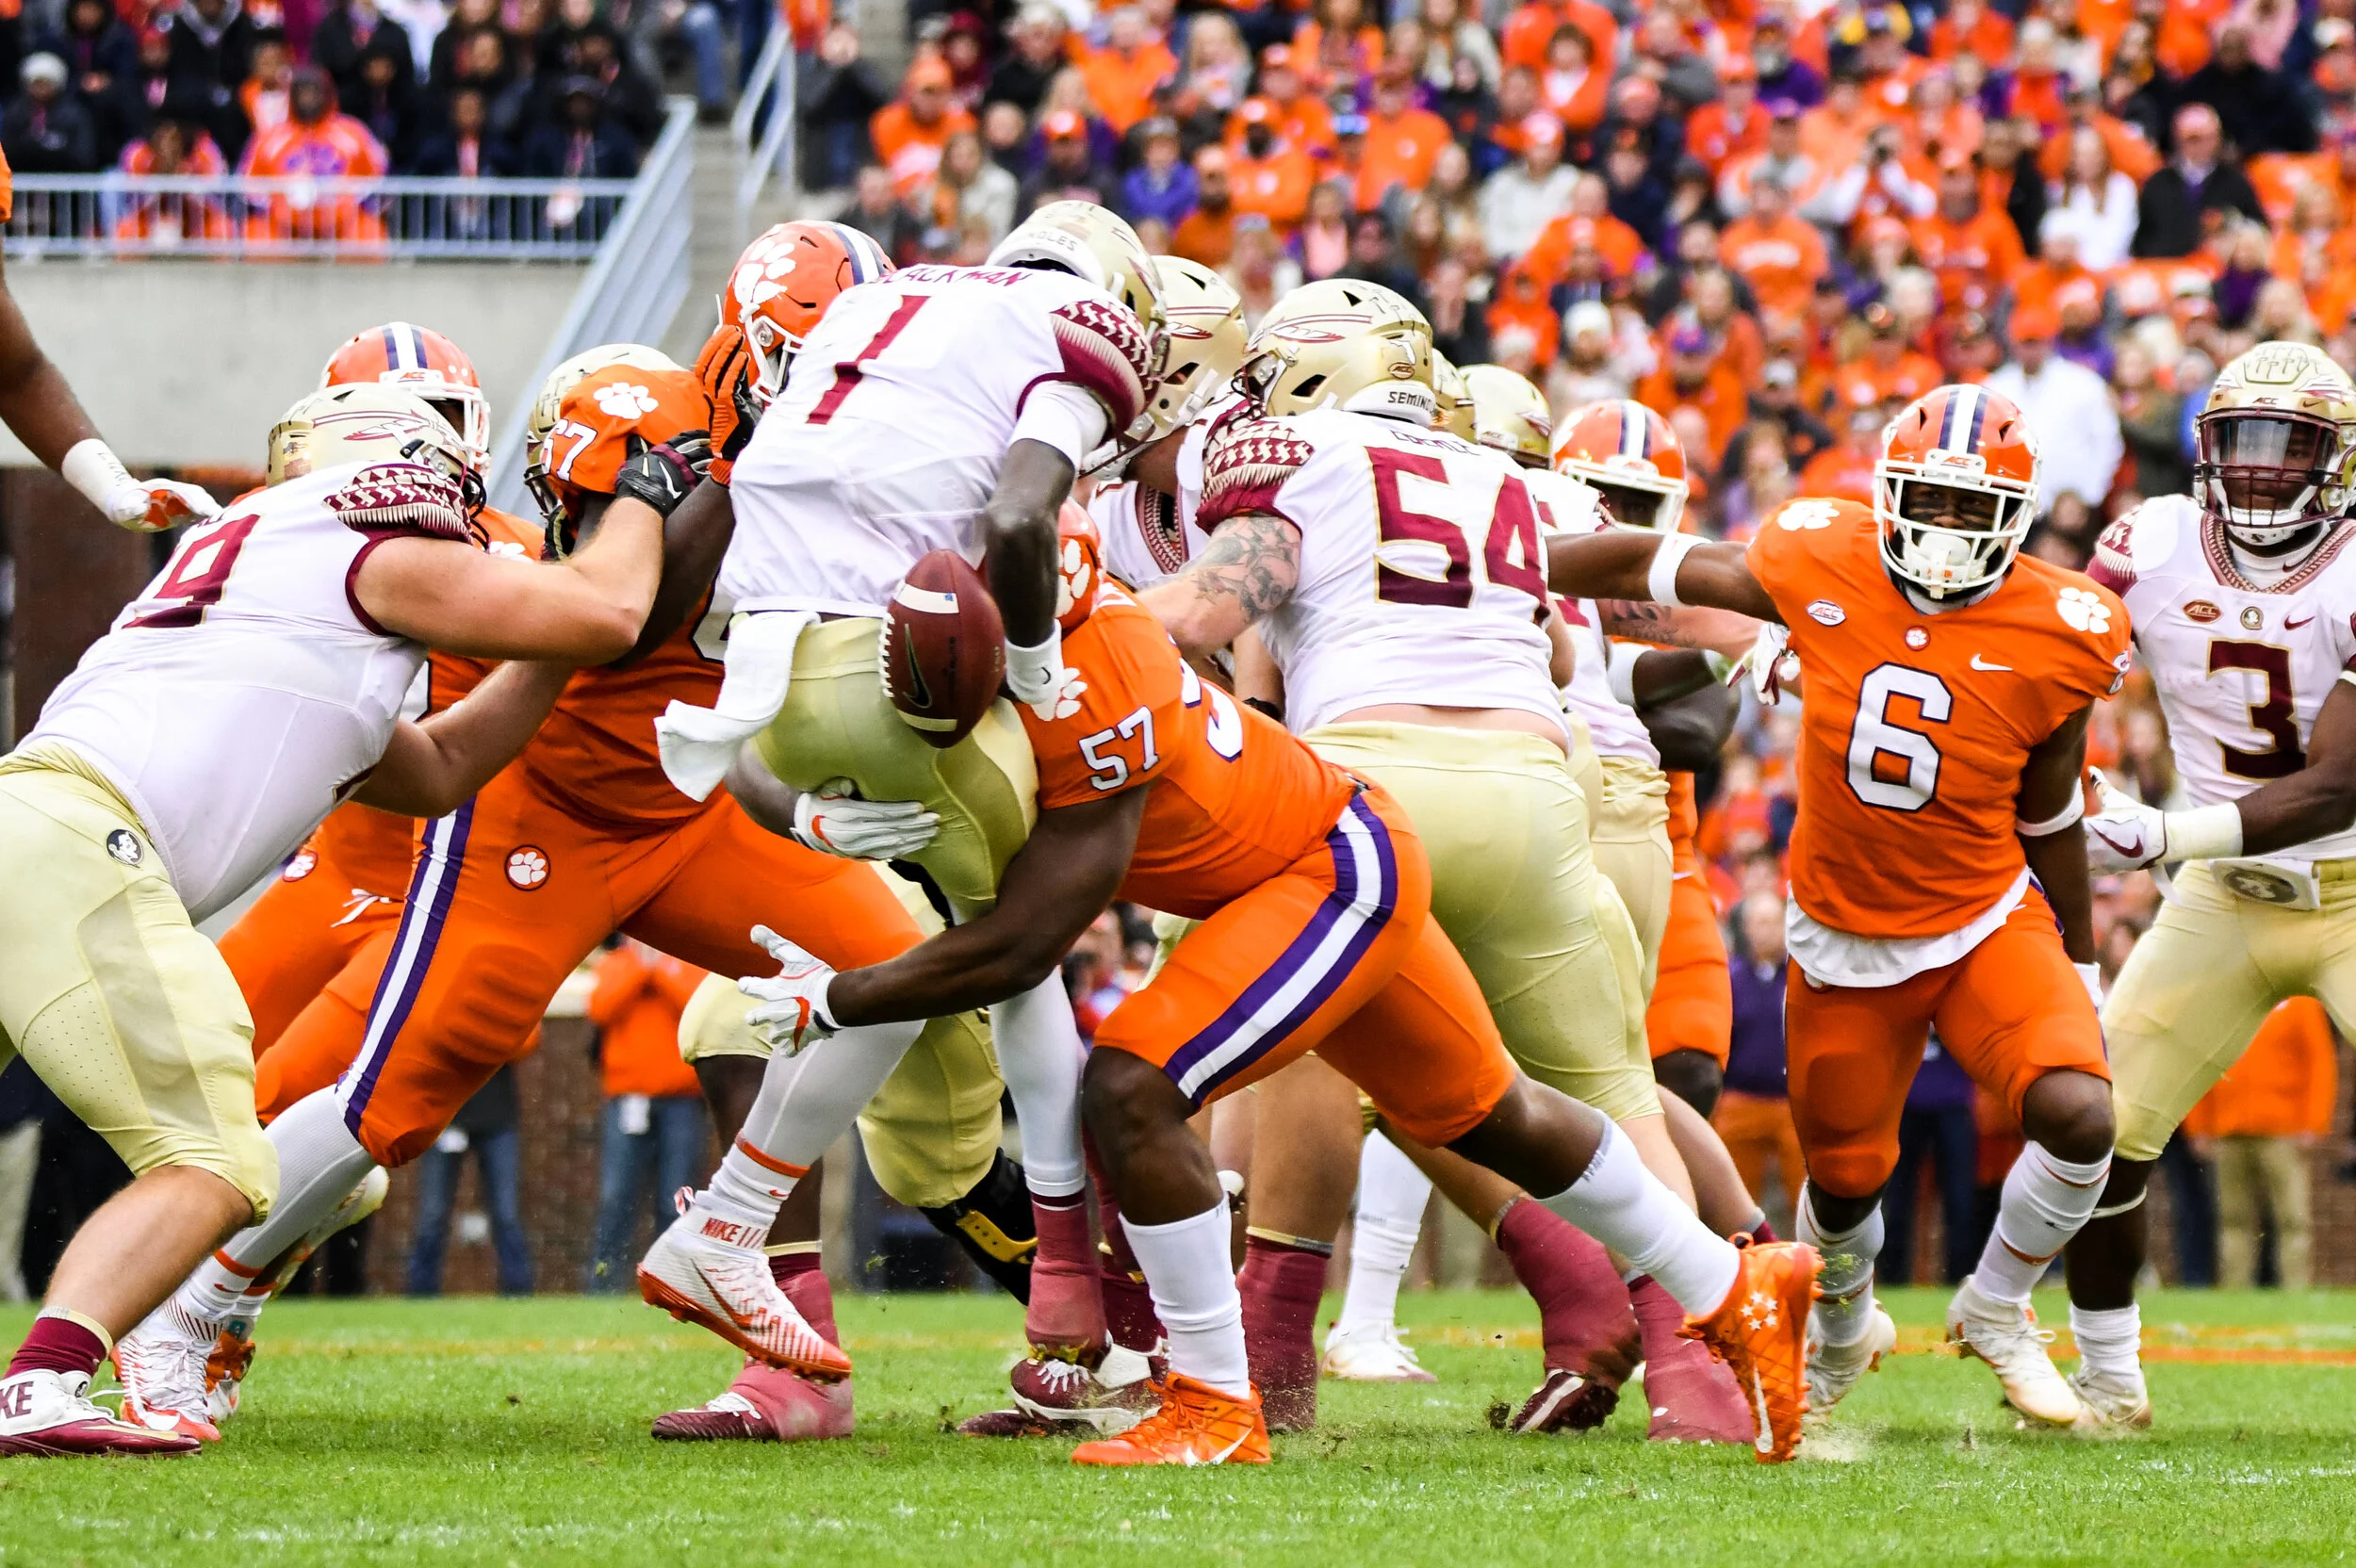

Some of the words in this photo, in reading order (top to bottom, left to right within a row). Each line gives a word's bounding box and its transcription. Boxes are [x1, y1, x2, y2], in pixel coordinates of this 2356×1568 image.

[399, 371, 426, 380] ACC
[808, 294, 930, 424] 1
[2251, 397, 2280, 405] ACC
[540, 418, 597, 482] 67
[1941, 456, 1972, 466] ACC
[1364, 446, 1552, 629] 54
[1812, 607, 1841, 619] ACC
[2187, 604, 2218, 615] ACC
[2206, 637, 2308, 784] 3
[1078, 705, 1159, 791] 57
[1844, 661, 1955, 813] 6
[700, 1217, 743, 1243] NIKE
